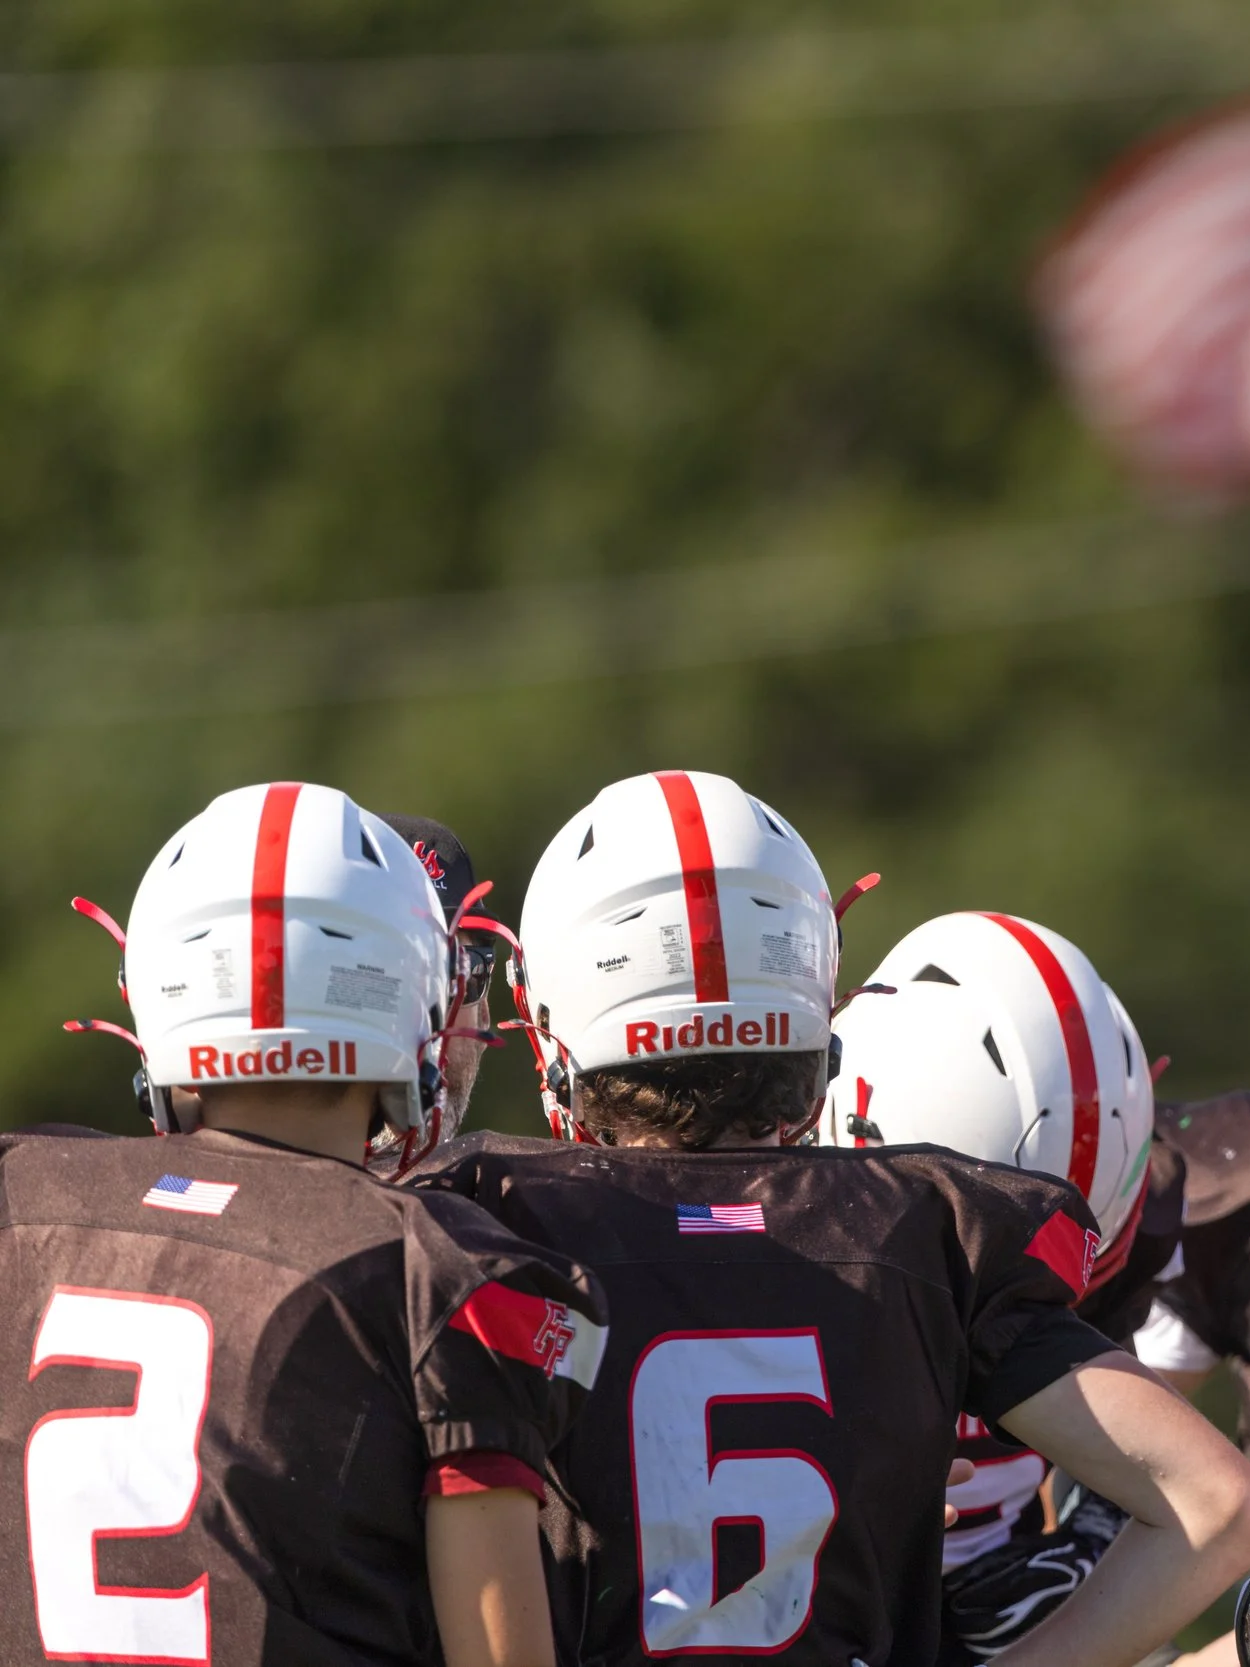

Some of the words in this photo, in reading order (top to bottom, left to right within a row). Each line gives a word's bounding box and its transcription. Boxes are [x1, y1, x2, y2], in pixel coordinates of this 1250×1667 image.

[596, 955, 628, 969] Riddell
[625, 1012, 789, 1056] Riddell
[189, 1040, 356, 1079] Riddell
[25, 1284, 214, 1667] 2
[630, 1326, 839, 1659] 6
